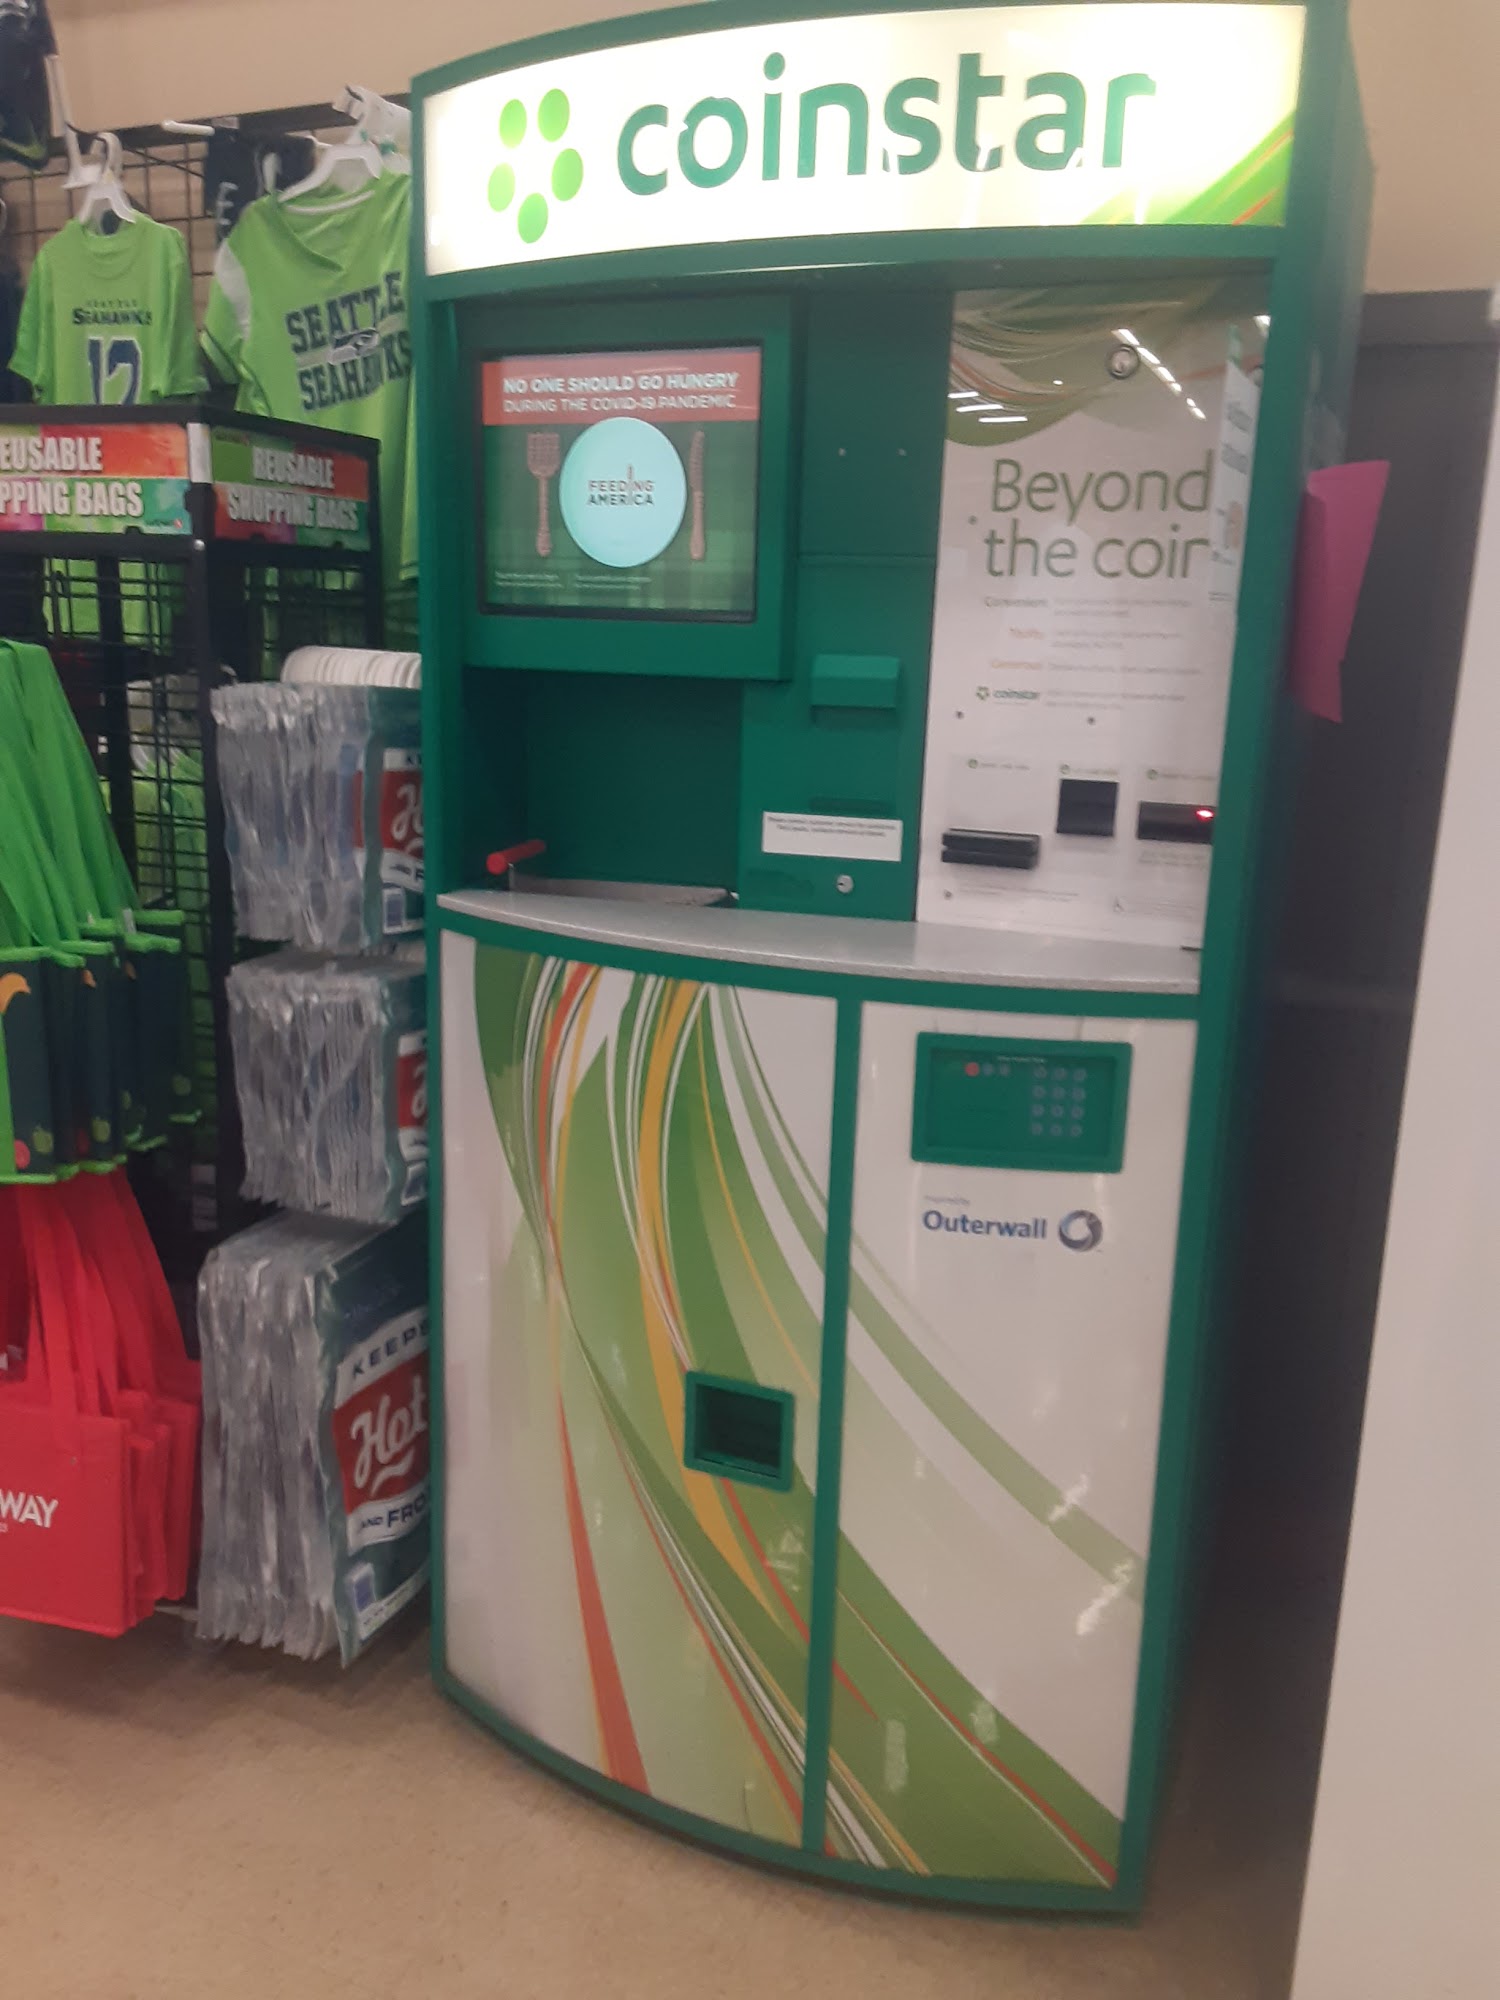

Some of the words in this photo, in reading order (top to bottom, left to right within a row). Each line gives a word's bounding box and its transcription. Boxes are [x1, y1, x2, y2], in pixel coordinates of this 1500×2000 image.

[617, 51, 1156, 196] coinstar
[503, 378, 528, 394] NO
[530, 377, 565, 393] ONE
[567, 375, 635, 392] SHOULD
[637, 374, 664, 390] GO
[666, 372, 739, 389] HUNGRY
[503, 399, 557, 414] DURING
[560, 397, 588, 412] THE
[590, 396, 657, 411] COVID-19
[658, 394, 736, 409] PANDEMIC
[252, 446, 335, 490] REUSABLE
[588, 479, 655, 493] FEEDING
[991, 449, 1214, 527] Beyond
[74, 480, 145, 518] BAGS
[227, 483, 316, 528] SHOPPING
[316, 497, 360, 531] BAGS
[587, 493, 655, 506] AMERICA
[984, 518, 1077, 578] the
[922, 1209, 1048, 1240] Outerwall
[351, 1374, 428, 1490] Hot
